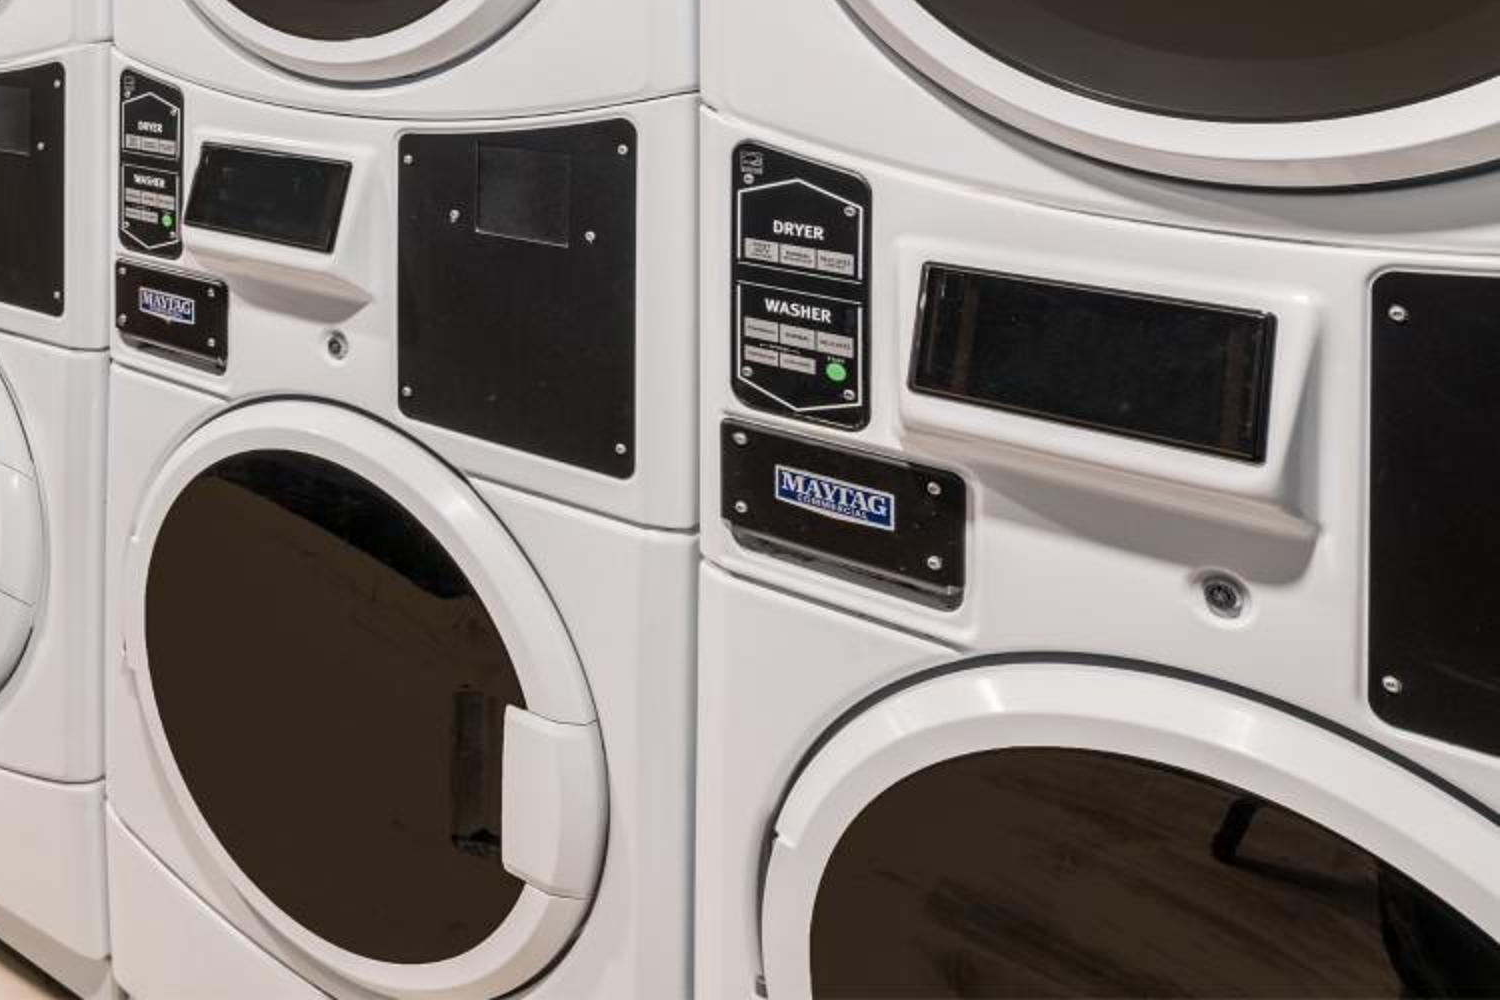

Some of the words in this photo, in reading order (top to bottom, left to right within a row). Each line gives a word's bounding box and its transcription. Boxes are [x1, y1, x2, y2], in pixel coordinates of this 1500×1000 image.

[772, 219, 825, 240] DRYER
[142, 289, 191, 315] MAYTAG
[764, 298, 832, 323] WASHER
[781, 471, 888, 517] MAYTAG
